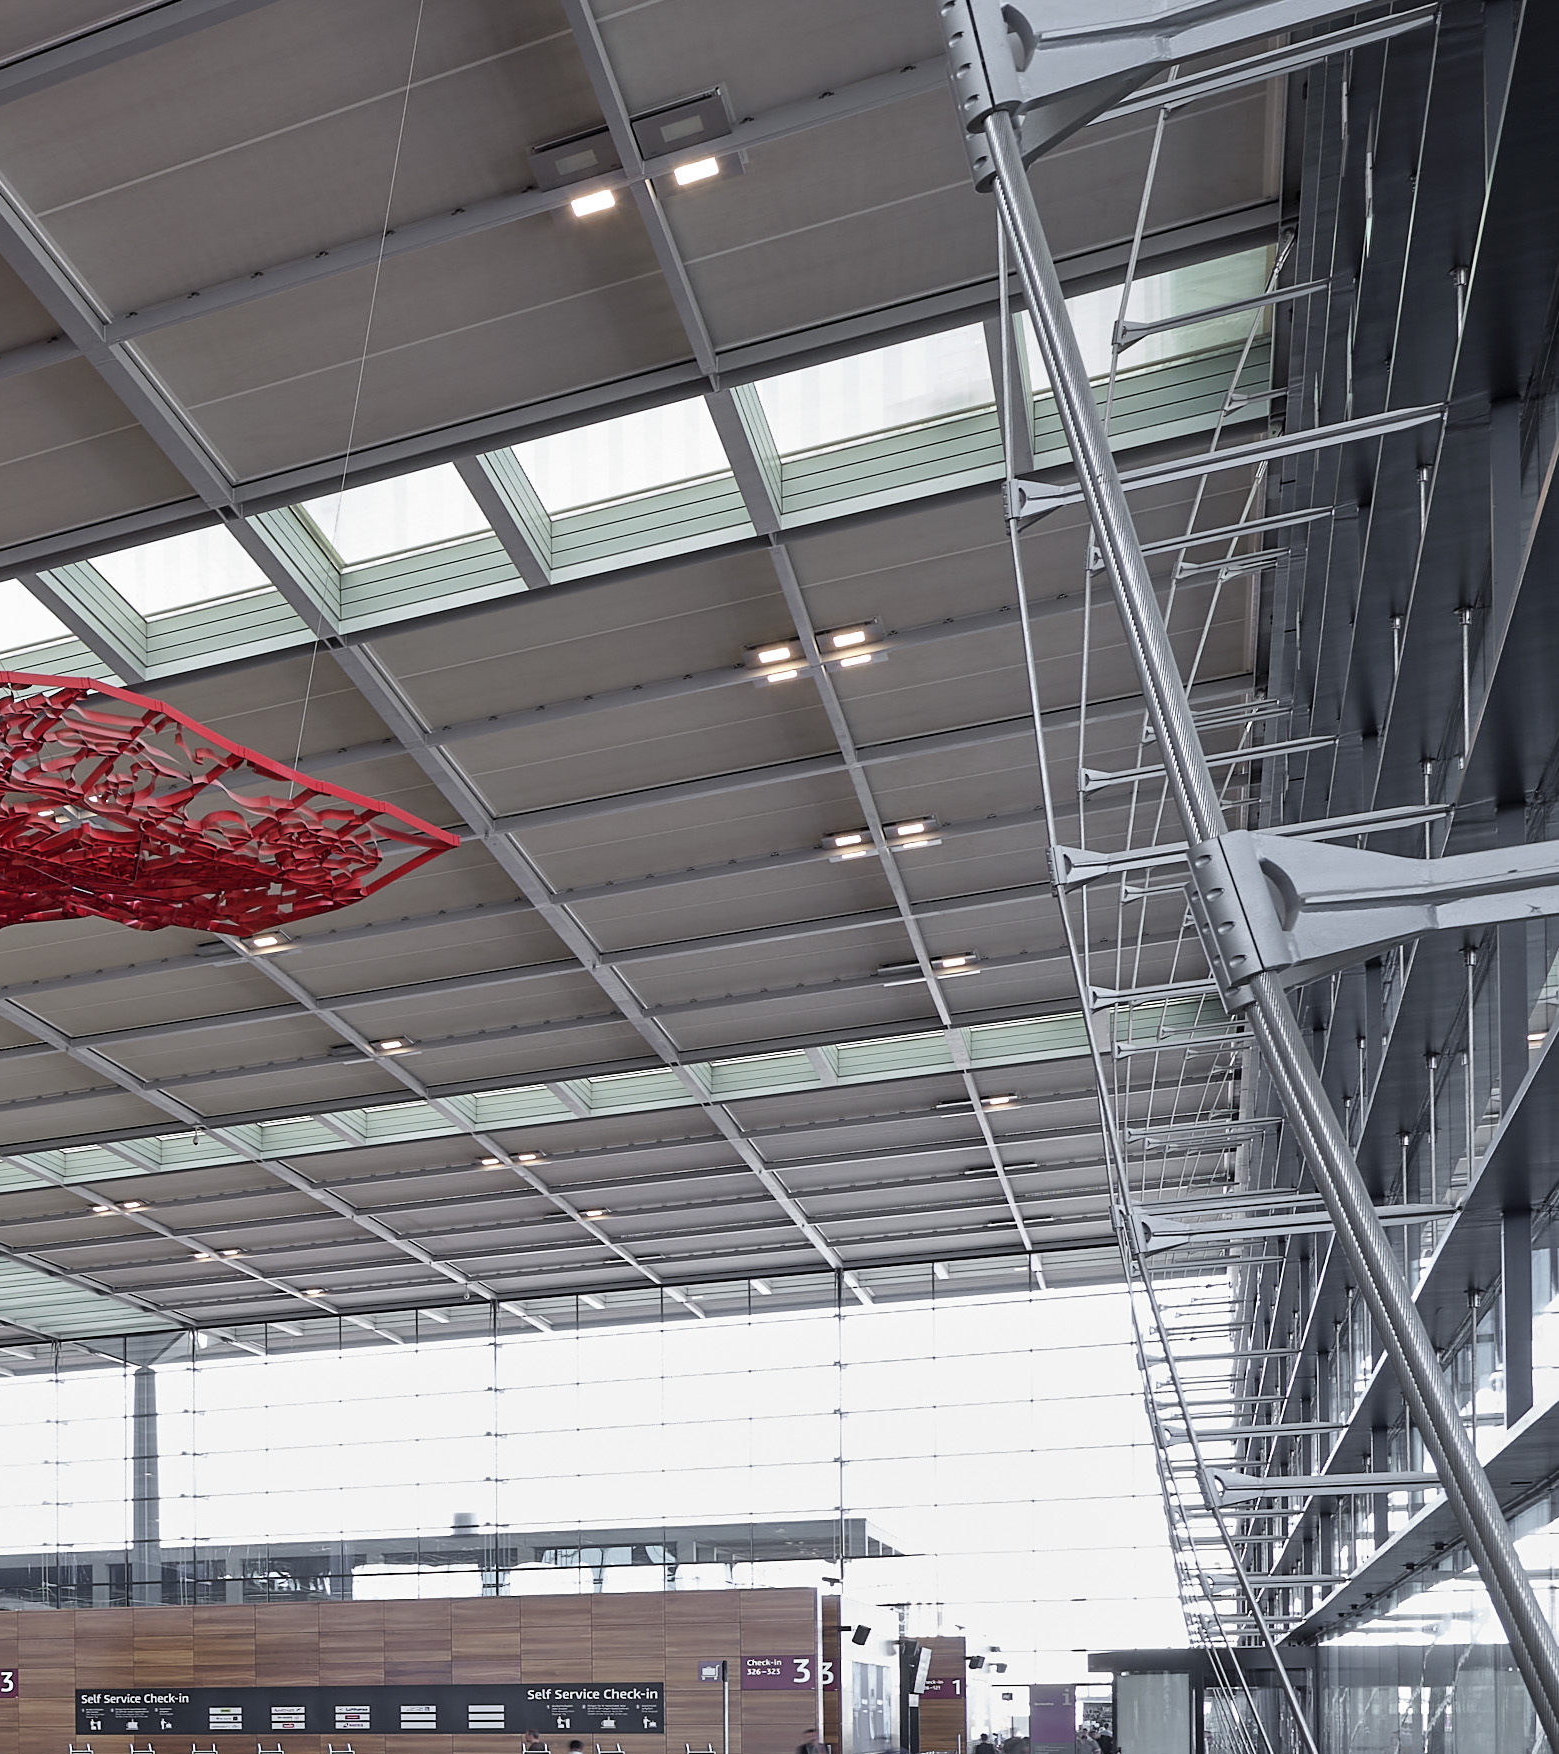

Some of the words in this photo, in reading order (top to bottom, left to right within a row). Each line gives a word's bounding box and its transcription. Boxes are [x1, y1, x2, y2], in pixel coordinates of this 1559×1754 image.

[746, 1658, 782, 1667] Check-in
[793, 1658, 811, 1683] 3
[822, 1661, 834, 1685] 3
[0, 1671, 14, 1692] 3
[952, 1679, 961, 1695] 1
[81, 1693, 102, 1704] Self
[104, 1693, 141, 1704] Service
[143, 1692, 190, 1704] Check-in
[527, 1688, 552, 1700] Self
[555, 1688, 600, 1700] Service
[603, 1688, 658, 1700] Check-in
